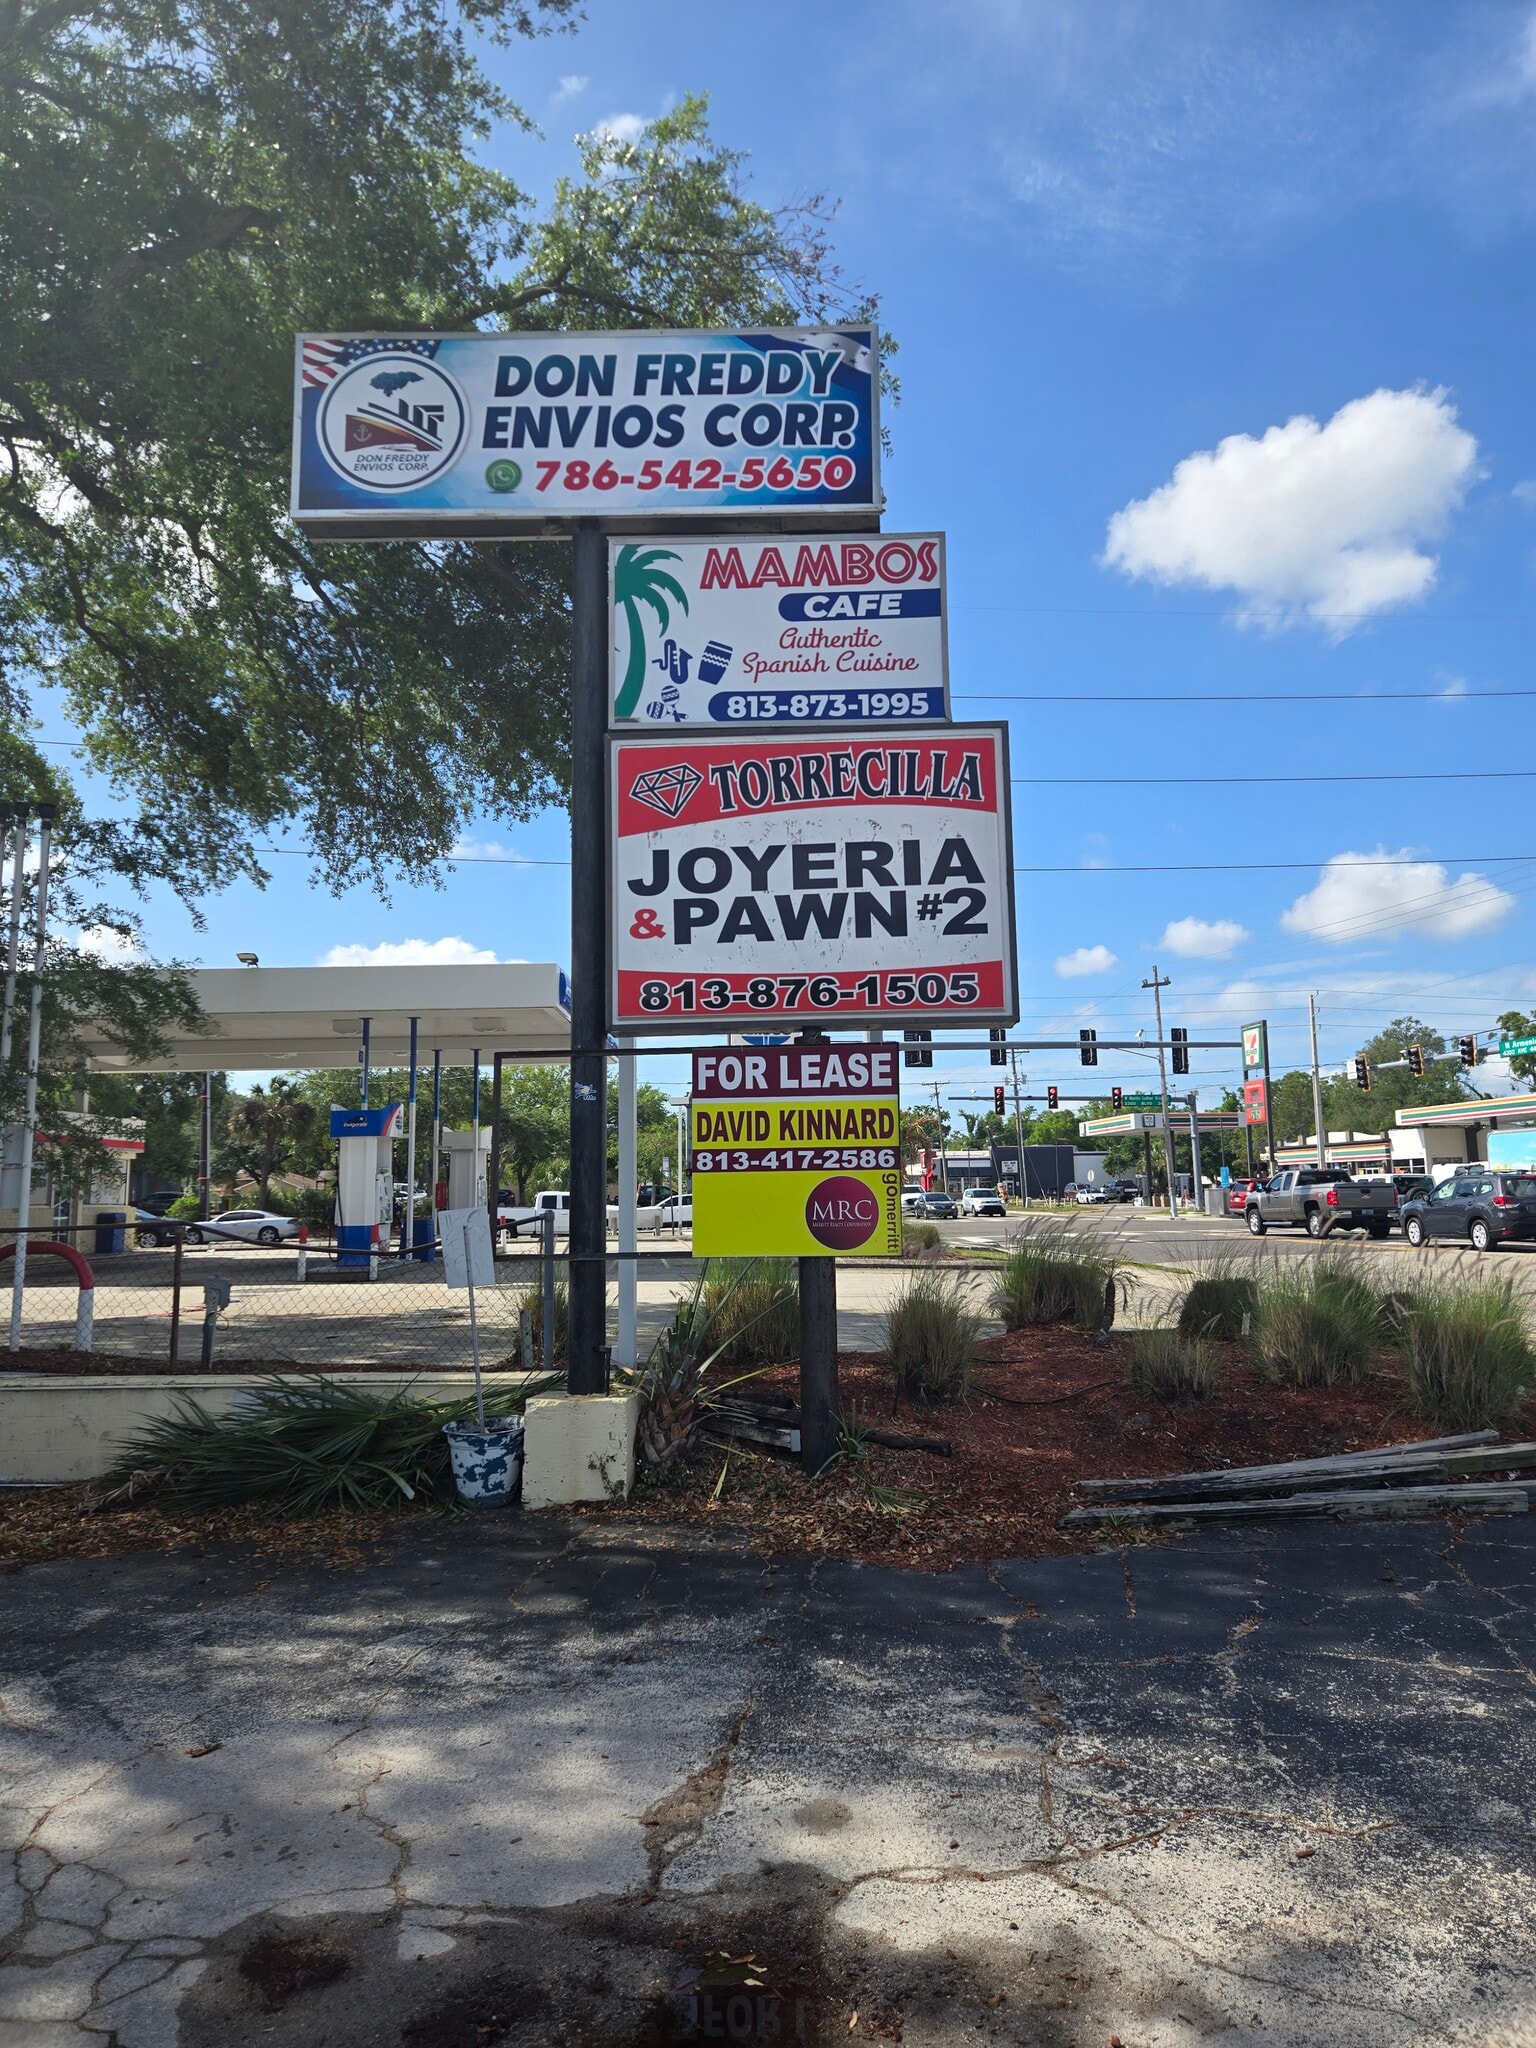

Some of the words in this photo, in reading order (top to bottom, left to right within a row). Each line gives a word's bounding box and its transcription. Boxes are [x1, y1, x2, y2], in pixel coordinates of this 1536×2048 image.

[494, 354, 617, 398] DON
[633, 350, 845, 396] FREDDY
[481, 404, 687, 449] ENVIOS
[703, 403, 857, 448] CORP.
[353, 462, 394, 472] ENVIOS
[356, 454, 384, 463] DON
[385, 453, 430, 463] FREDDY
[533, 457, 856, 494] 786-542-5650
[700, 541, 938, 589] MAMBOS
[803, 593, 903, 619] CAFE
[778, 626, 883, 650] Authentic
[741, 651, 830, 684] Spanish
[836, 650, 920, 673] Cuisine
[726, 692, 929, 719] 813-873-1995
[708, 745, 985, 813] TORRECILLA
[626, 837, 986, 897] JOYERIA
[628, 907, 667, 940] &
[673, 890, 909, 945] PAWN
[639, 972, 980, 1012] 813-876-1505
[697, 1055, 768, 1091] FOR
[779, 1052, 893, 1090] LEASE
[696, 1110, 771, 1143] DAVID
[779, 1108, 895, 1141] KINNARD
[696, 1149, 896, 1171] 813-417-2586
[812, 1199, 873, 1221] MRC
[881, 1172, 900, 1249] gomerritt
